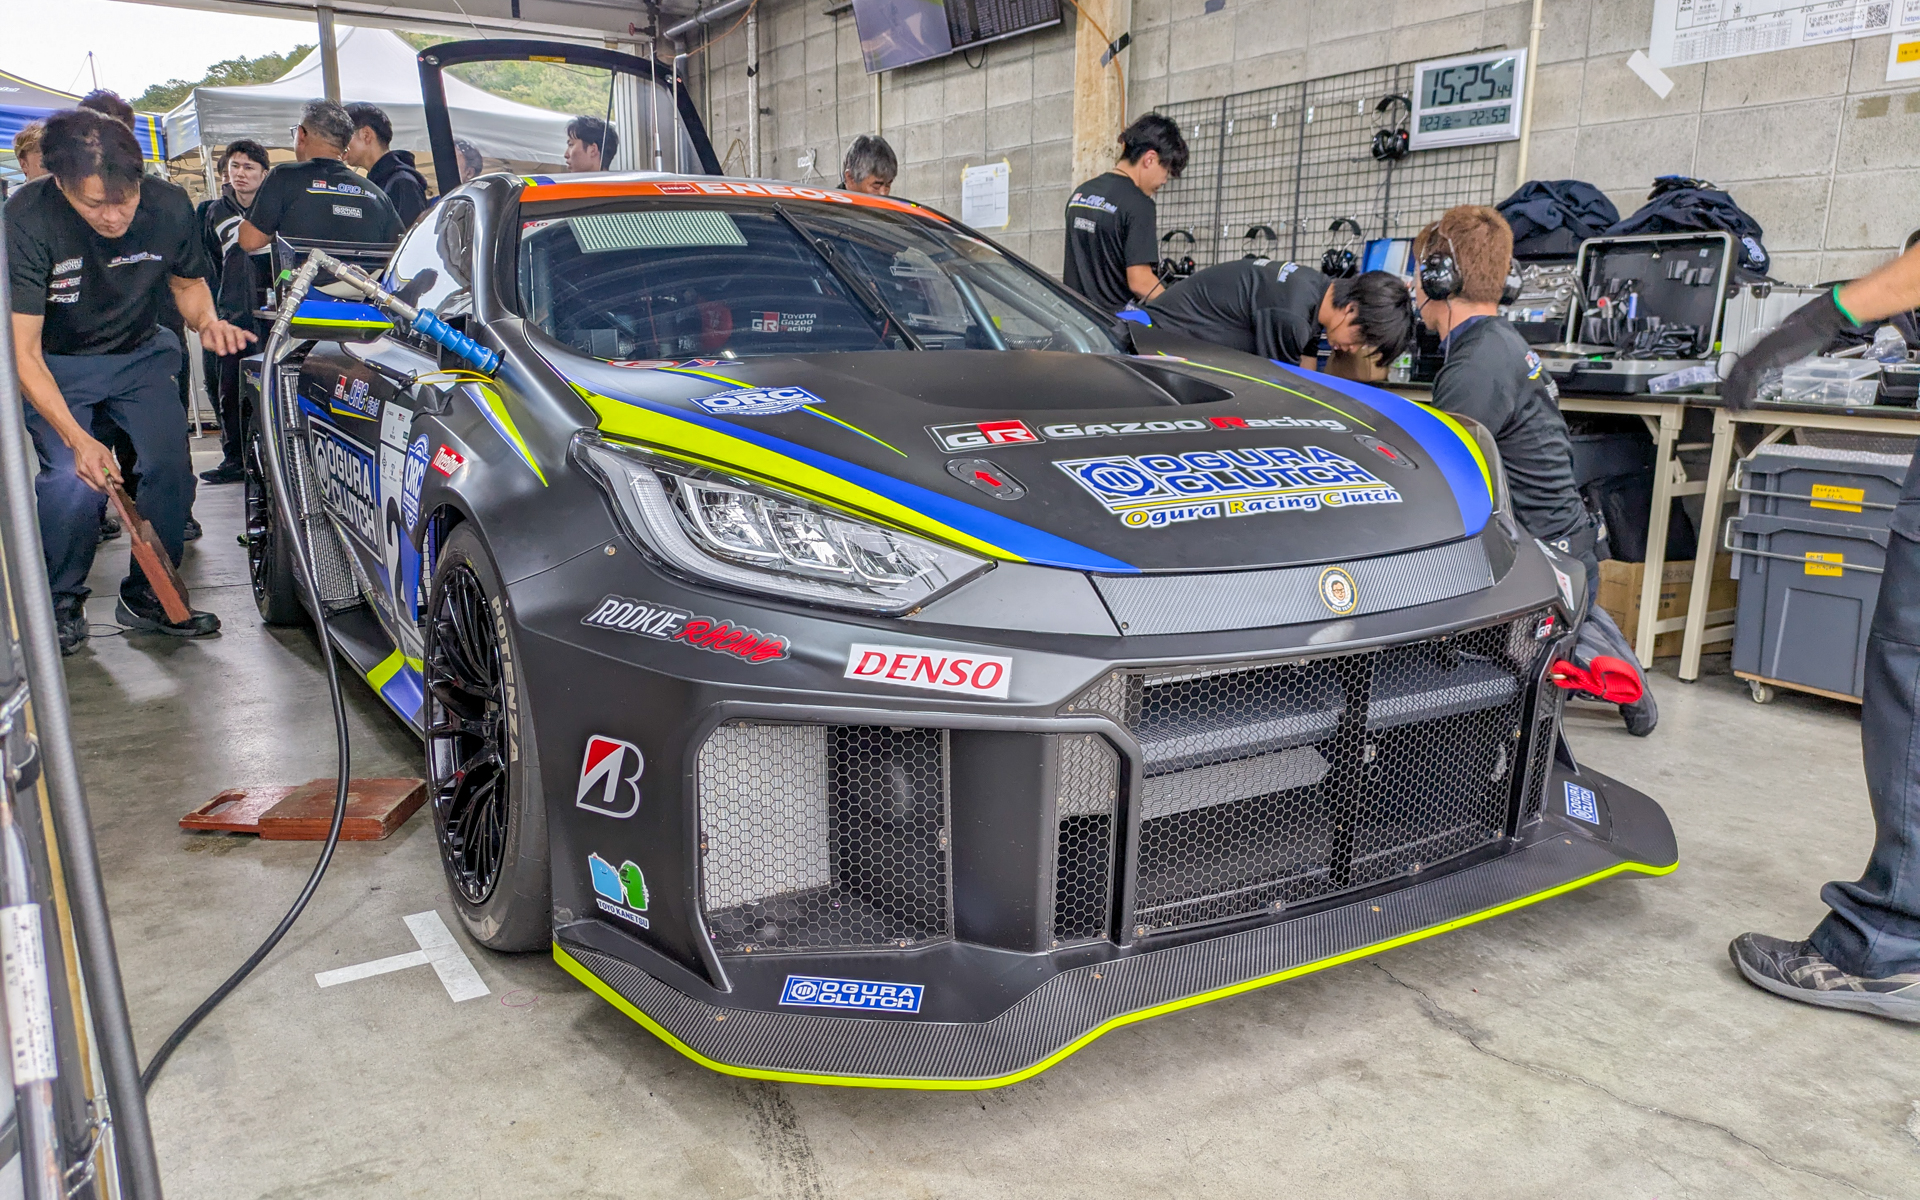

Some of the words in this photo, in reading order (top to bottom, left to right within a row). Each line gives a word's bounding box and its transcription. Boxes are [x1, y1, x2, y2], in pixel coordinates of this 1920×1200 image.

[1431, 63, 1496, 107] 15:25
[1497, 83, 1512, 98] 44
[696, 183, 853, 203] ENEOS
[751, 318, 778, 332] GR
[781, 325, 813, 333] Racing
[702, 388, 804, 408] ORC
[945, 427, 1034, 448] GR
[1043, 418, 1206, 437] GAZOO
[1209, 416, 1347, 431] Racing
[327, 439, 373, 503] OGURA
[1137, 445, 1354, 474] OGURA
[405, 455, 424, 500] ORC
[1164, 464, 1382, 496] CLUTCH
[331, 478, 378, 546] CLUTCH
[1125, 505, 1217, 526] Ogura
[1229, 494, 1317, 514] Racing
[1325, 489, 1401, 506] Clutch
[587, 599, 688, 637] ROOKIE
[675, 620, 783, 661] RACING
[1537, 624, 1552, 638] GR
[491, 595, 518, 762] POTENZA
[853, 651, 1004, 690] DENSO
[598, 900, 616, 913] TOYO
[615, 907, 648, 928] KANETSU
[818, 992, 915, 1009] CLUTCH
[821, 982, 916, 999] OGURA
